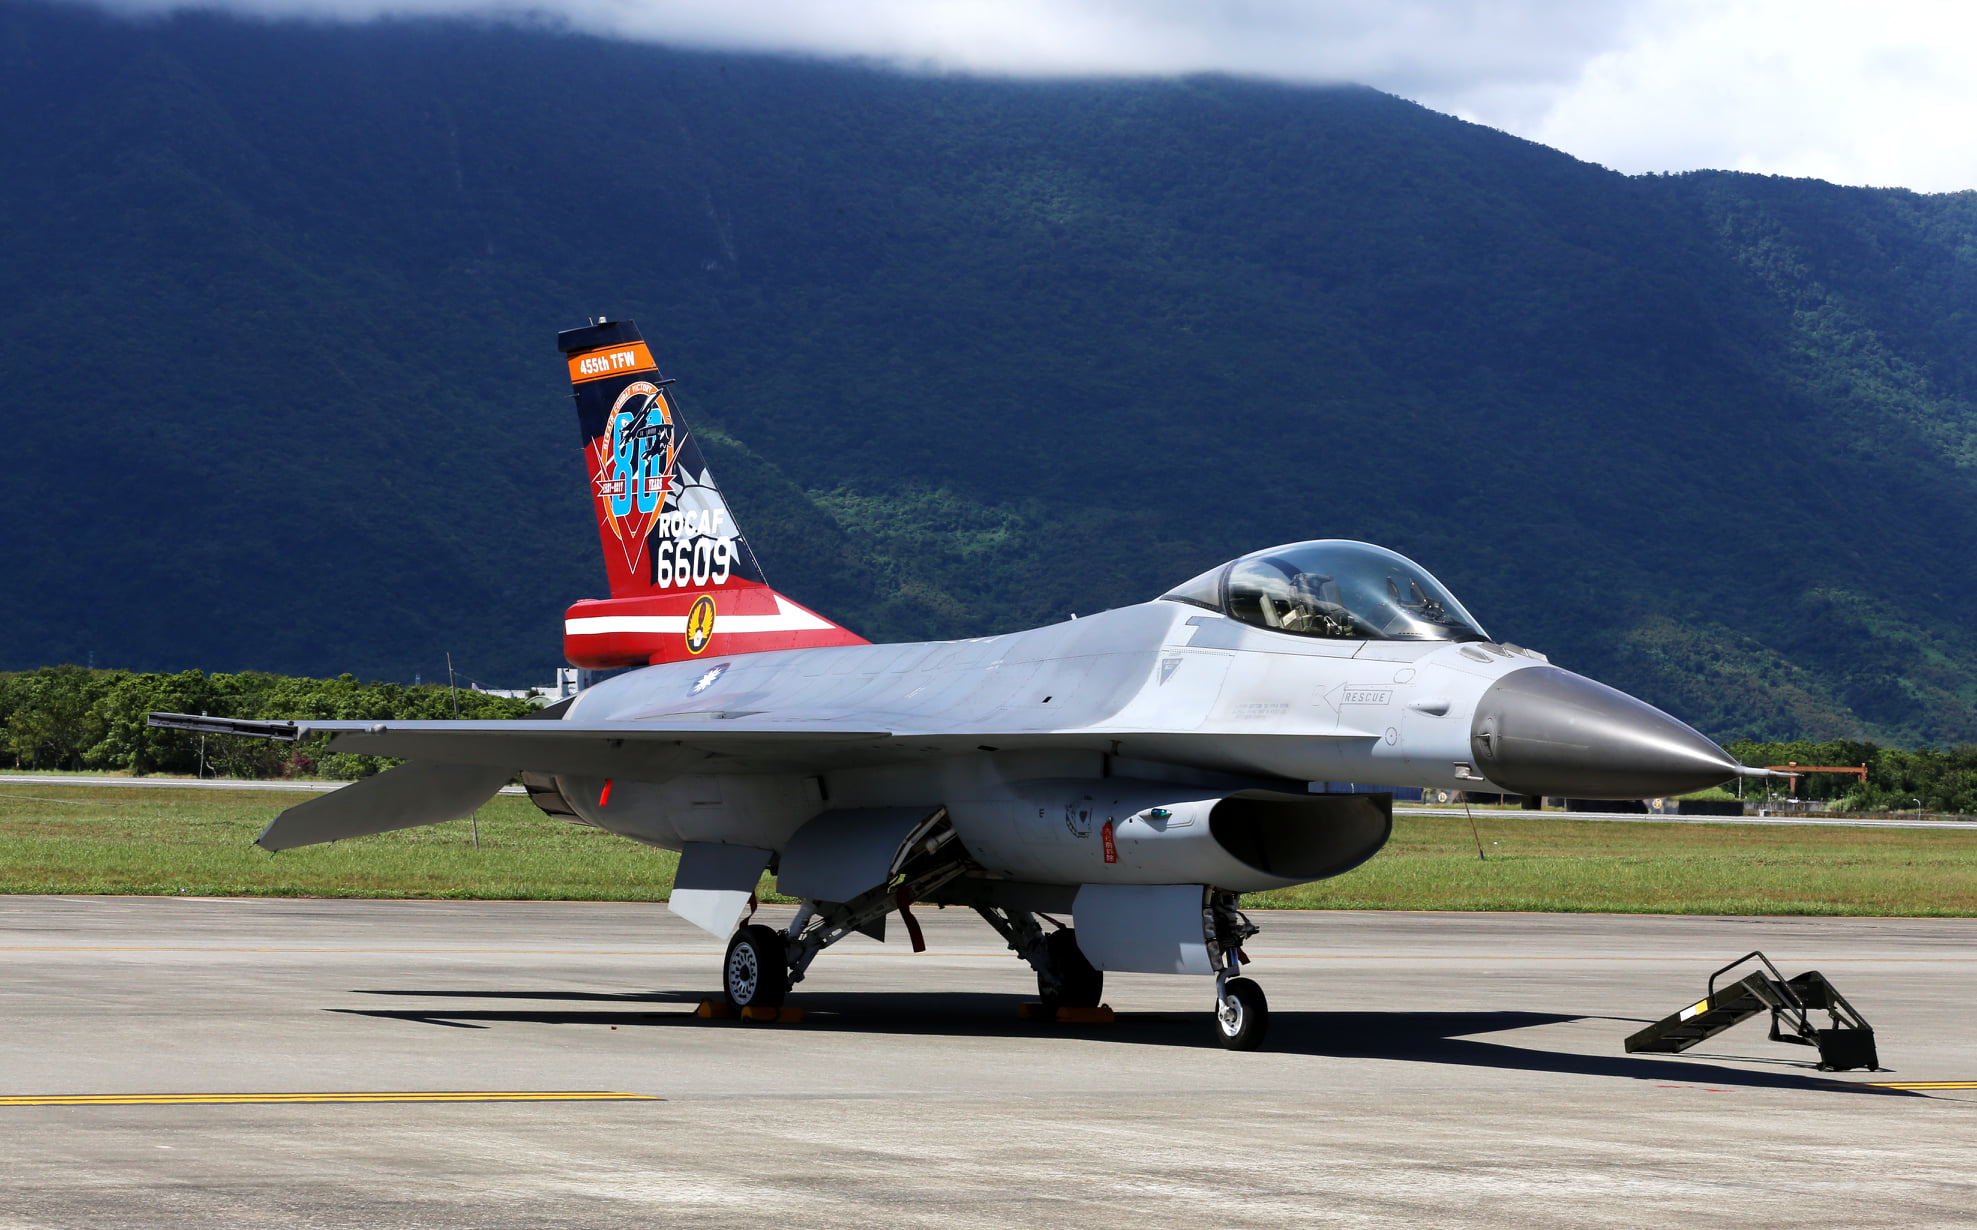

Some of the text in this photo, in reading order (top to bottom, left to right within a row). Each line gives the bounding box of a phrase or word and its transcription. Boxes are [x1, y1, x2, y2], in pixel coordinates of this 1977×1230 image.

[580, 351, 635, 375] 455th TFW
[632, 383, 653, 393] VICTORY
[648, 478, 663, 491] YEARS
[658, 508, 725, 539] ROCAF
[657, 536, 732, 589] 6609
[1344, 692, 1386, 702] RESCUE
